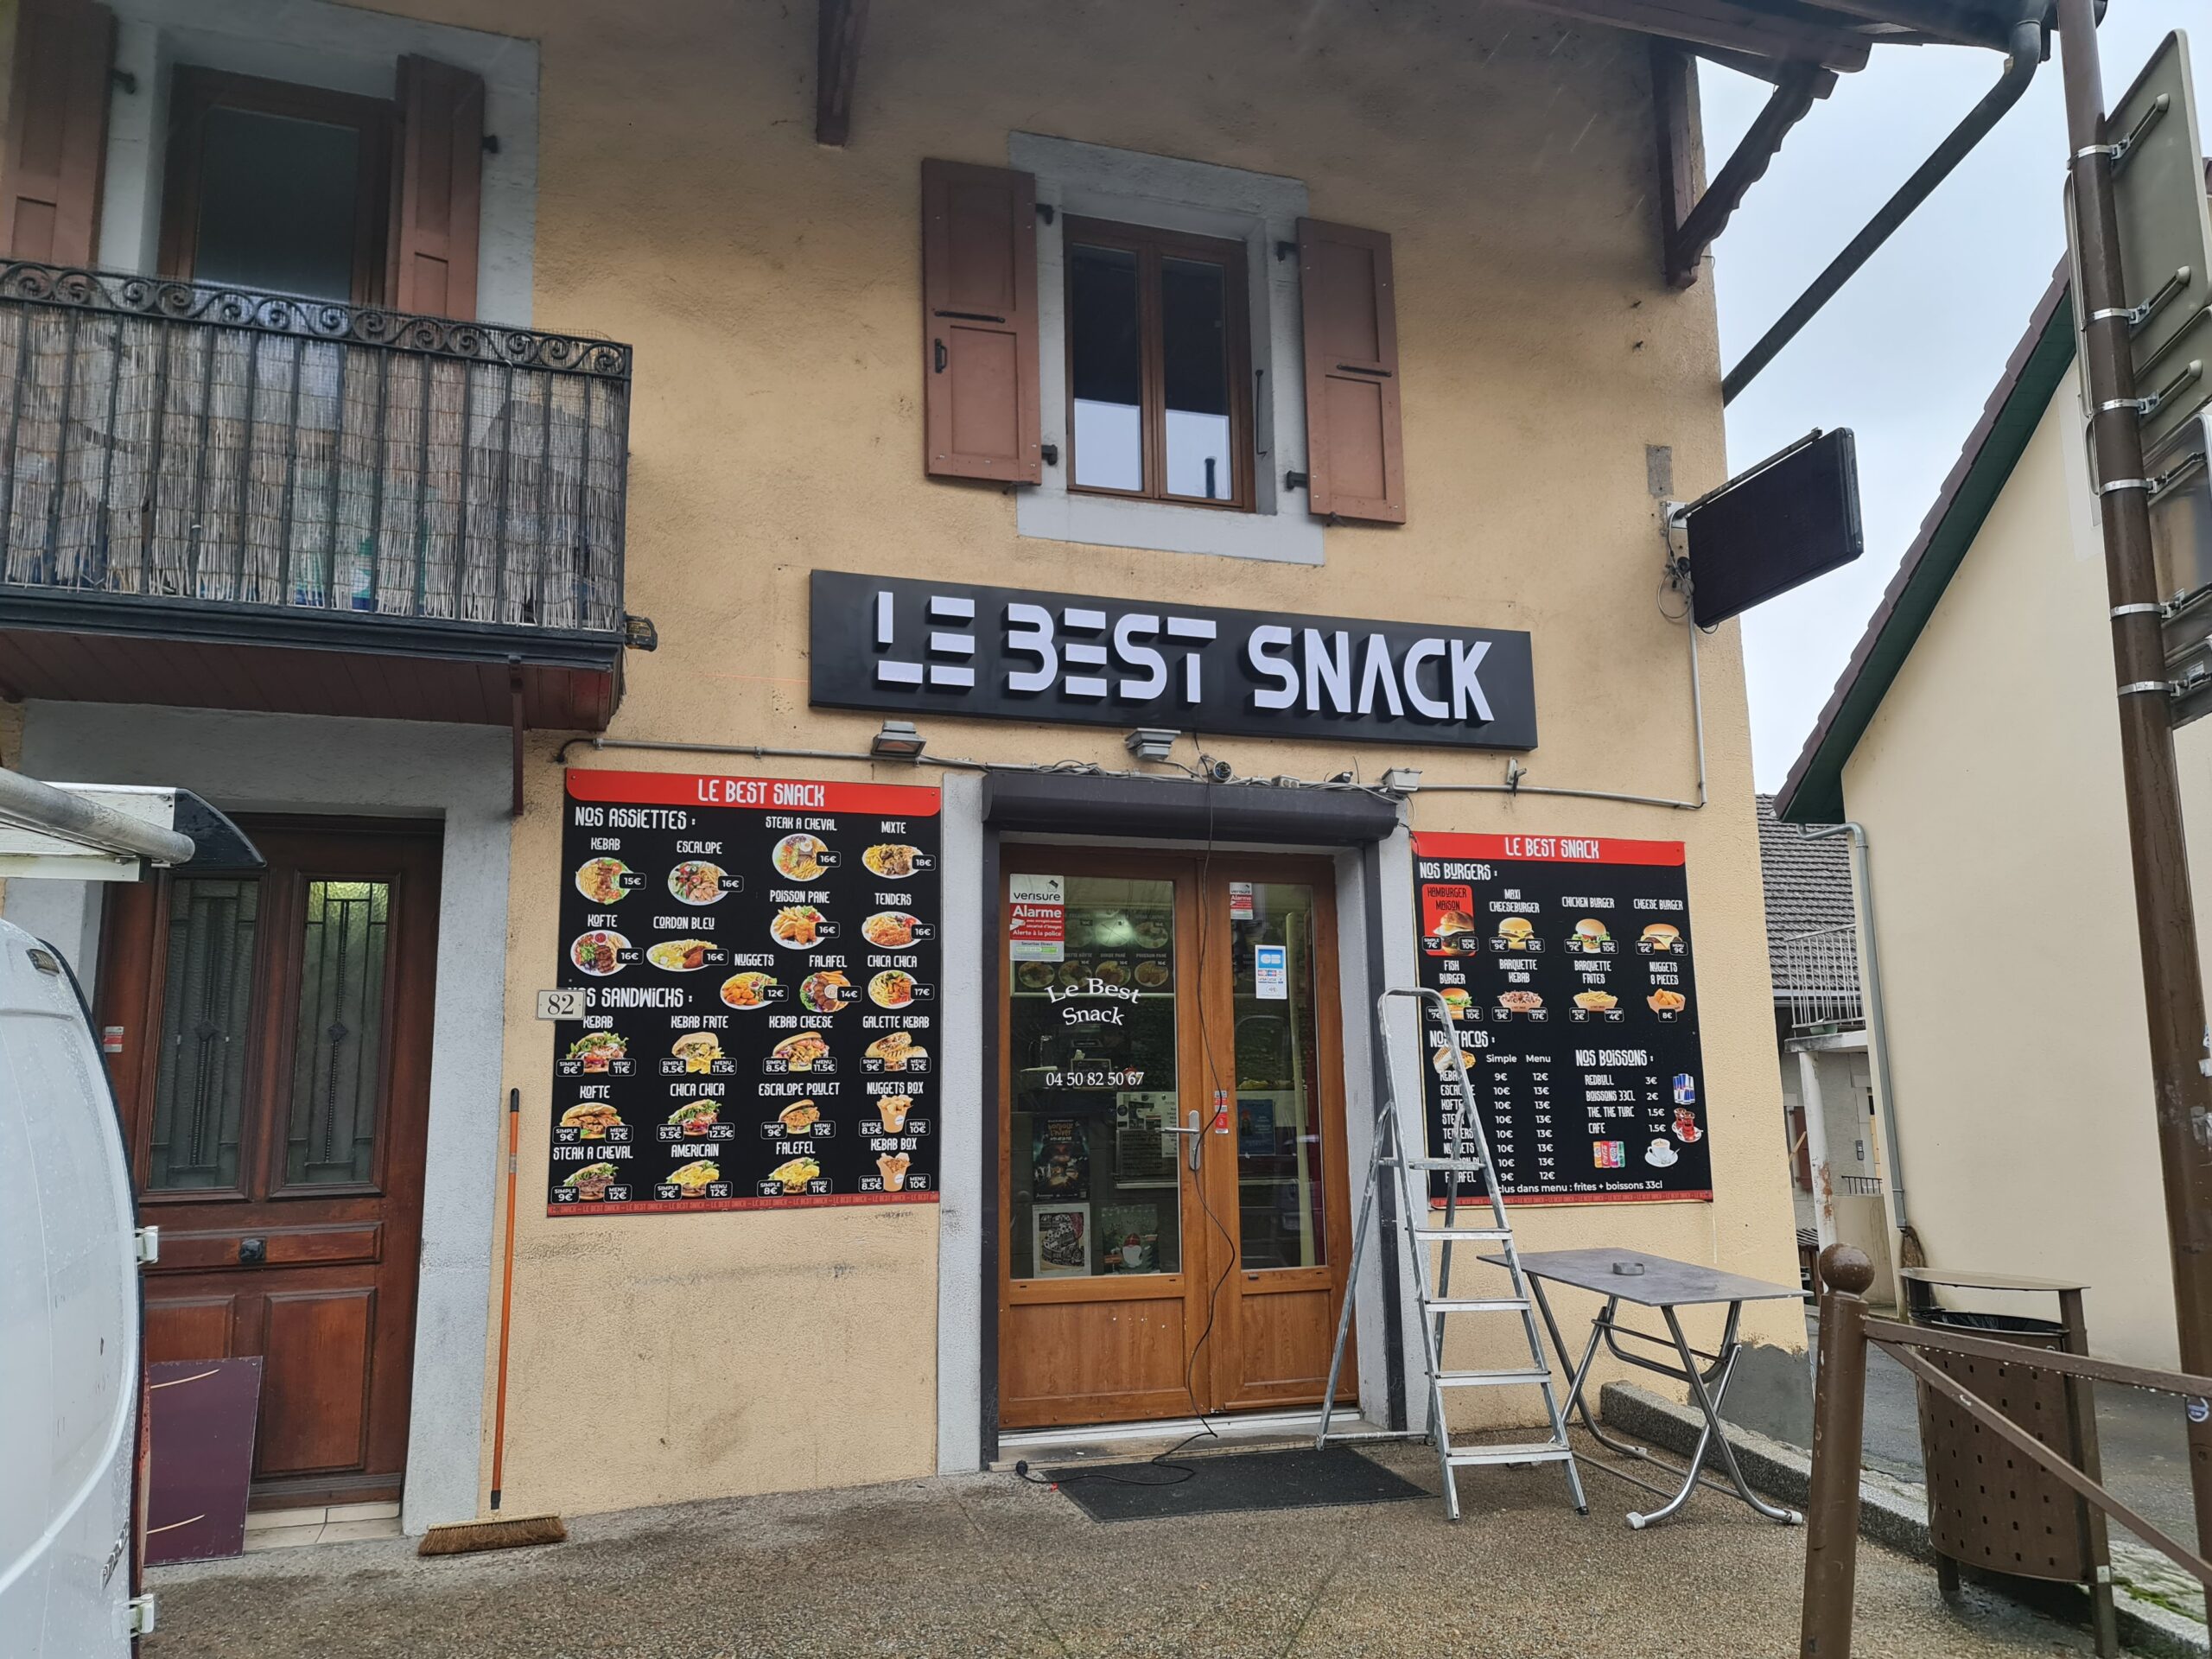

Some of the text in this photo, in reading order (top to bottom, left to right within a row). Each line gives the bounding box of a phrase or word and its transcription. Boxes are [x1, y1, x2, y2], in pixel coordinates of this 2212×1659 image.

[877, 591, 1493, 721] LE BEST SNACK
[697, 779, 824, 807] LE BEST SNACK
[575, 806, 687, 830] NOS ASSIETTES
[765, 816, 837, 831] STEAK A CHEVAL
[881, 821, 906, 835] MIXTE
[590, 836, 620, 851] KEBAB
[677, 841, 722, 855] ESCALOPE
[1505, 836, 1599, 859] LE BEST SNACK
[820, 855, 836, 864] 16€
[915, 858, 931, 867] 18€
[1420, 861, 1491, 880] NOS BURGERS
[624, 876, 642, 886] 15€
[722, 880, 740, 888] 16€
[770, 890, 830, 904] POISSON PANE
[1014, 892, 1061, 901] verisure
[1427, 887, 1467, 899] HAMBURGER
[874, 893, 912, 906] TENDERS
[1561, 896, 1615, 909] CHICKEN BURGER
[1633, 899, 1683, 911] CHEESE BURGER
[1013, 905, 1062, 918] Alarme
[1489, 901, 1540, 913] CHEESEBURGER
[587, 914, 618, 928] KOFTE
[652, 915, 715, 930] CORDON BLEU
[819, 925, 836, 935] 16€
[915, 927, 931, 936] 16€
[621, 951, 639, 961] 16€
[707, 952, 724, 962] 16€
[734, 953, 774, 967] NUGGETS
[809, 955, 847, 968] FALAFEL
[868, 954, 917, 969] CHICA CHICA
[1444, 960, 1459, 971] FISH
[1499, 958, 1538, 970] BARQUETTE
[1574, 960, 1612, 972] BARQUETTE
[1649, 962, 1677, 973] NUGGETS
[1440, 973, 1466, 984] BURGER
[1508, 972, 1530, 983] KEBAB
[1582, 973, 1605, 984] FRITES
[1656, 975, 1679, 985] PIECES
[767, 989, 784, 998] 12€
[841, 990, 857, 999] 14€
[914, 988, 930, 996] 17€
[1044, 977, 1141, 1005] Le Best
[547, 994, 575, 1015] 82
[583, 1015, 613, 1028] KEBAB
[671, 1015, 729, 1028] KEBAB FRITE
[769, 1015, 833, 1028] KEBAB CHEESE
[862, 1016, 930, 1028] GALETTE KEBAB
[1063, 1007, 1125, 1027] Snack
[1486, 1054, 1517, 1065] Simple
[1575, 1050, 1648, 1066] NOS BOISSONS
[1046, 1071, 1144, 1086] 04 50 82 50 67
[1440, 1070, 1458, 1082] KEBA
[1532, 1072, 1548, 1081] 12€
[1585, 1074, 1615, 1085] REDBULL
[580, 1085, 610, 1098] KOFTE
[670, 1084, 725, 1096] CHICA CHICA
[759, 1083, 840, 1096] ESCALOPE POULET
[867, 1082, 924, 1095] NUGGETS BOX
[1440, 1084, 1476, 1096] ESCALE
[1493, 1087, 1510, 1096] 10€
[1586, 1090, 1636, 1102] BOISSONS 33CL
[1586, 1106, 1635, 1118] THE THE TURC
[1588, 1122, 1605, 1134] CAFE
[776, 1141, 816, 1154] FALEFEL
[871, 1138, 918, 1151] KEBAB BOX
[553, 1146, 633, 1160] STEAK A CHEVAL
[671, 1144, 719, 1158] AMERICAIN
[1445, 1172, 1477, 1183] FAFEL
[1539, 1172, 1555, 1180] 12€
[1517, 1185, 1539, 1193] dans
[1573, 1182, 1597, 1192] frites
[1605, 1181, 1643, 1191] boissons
[1645, 1180, 1662, 1189] 33cl
